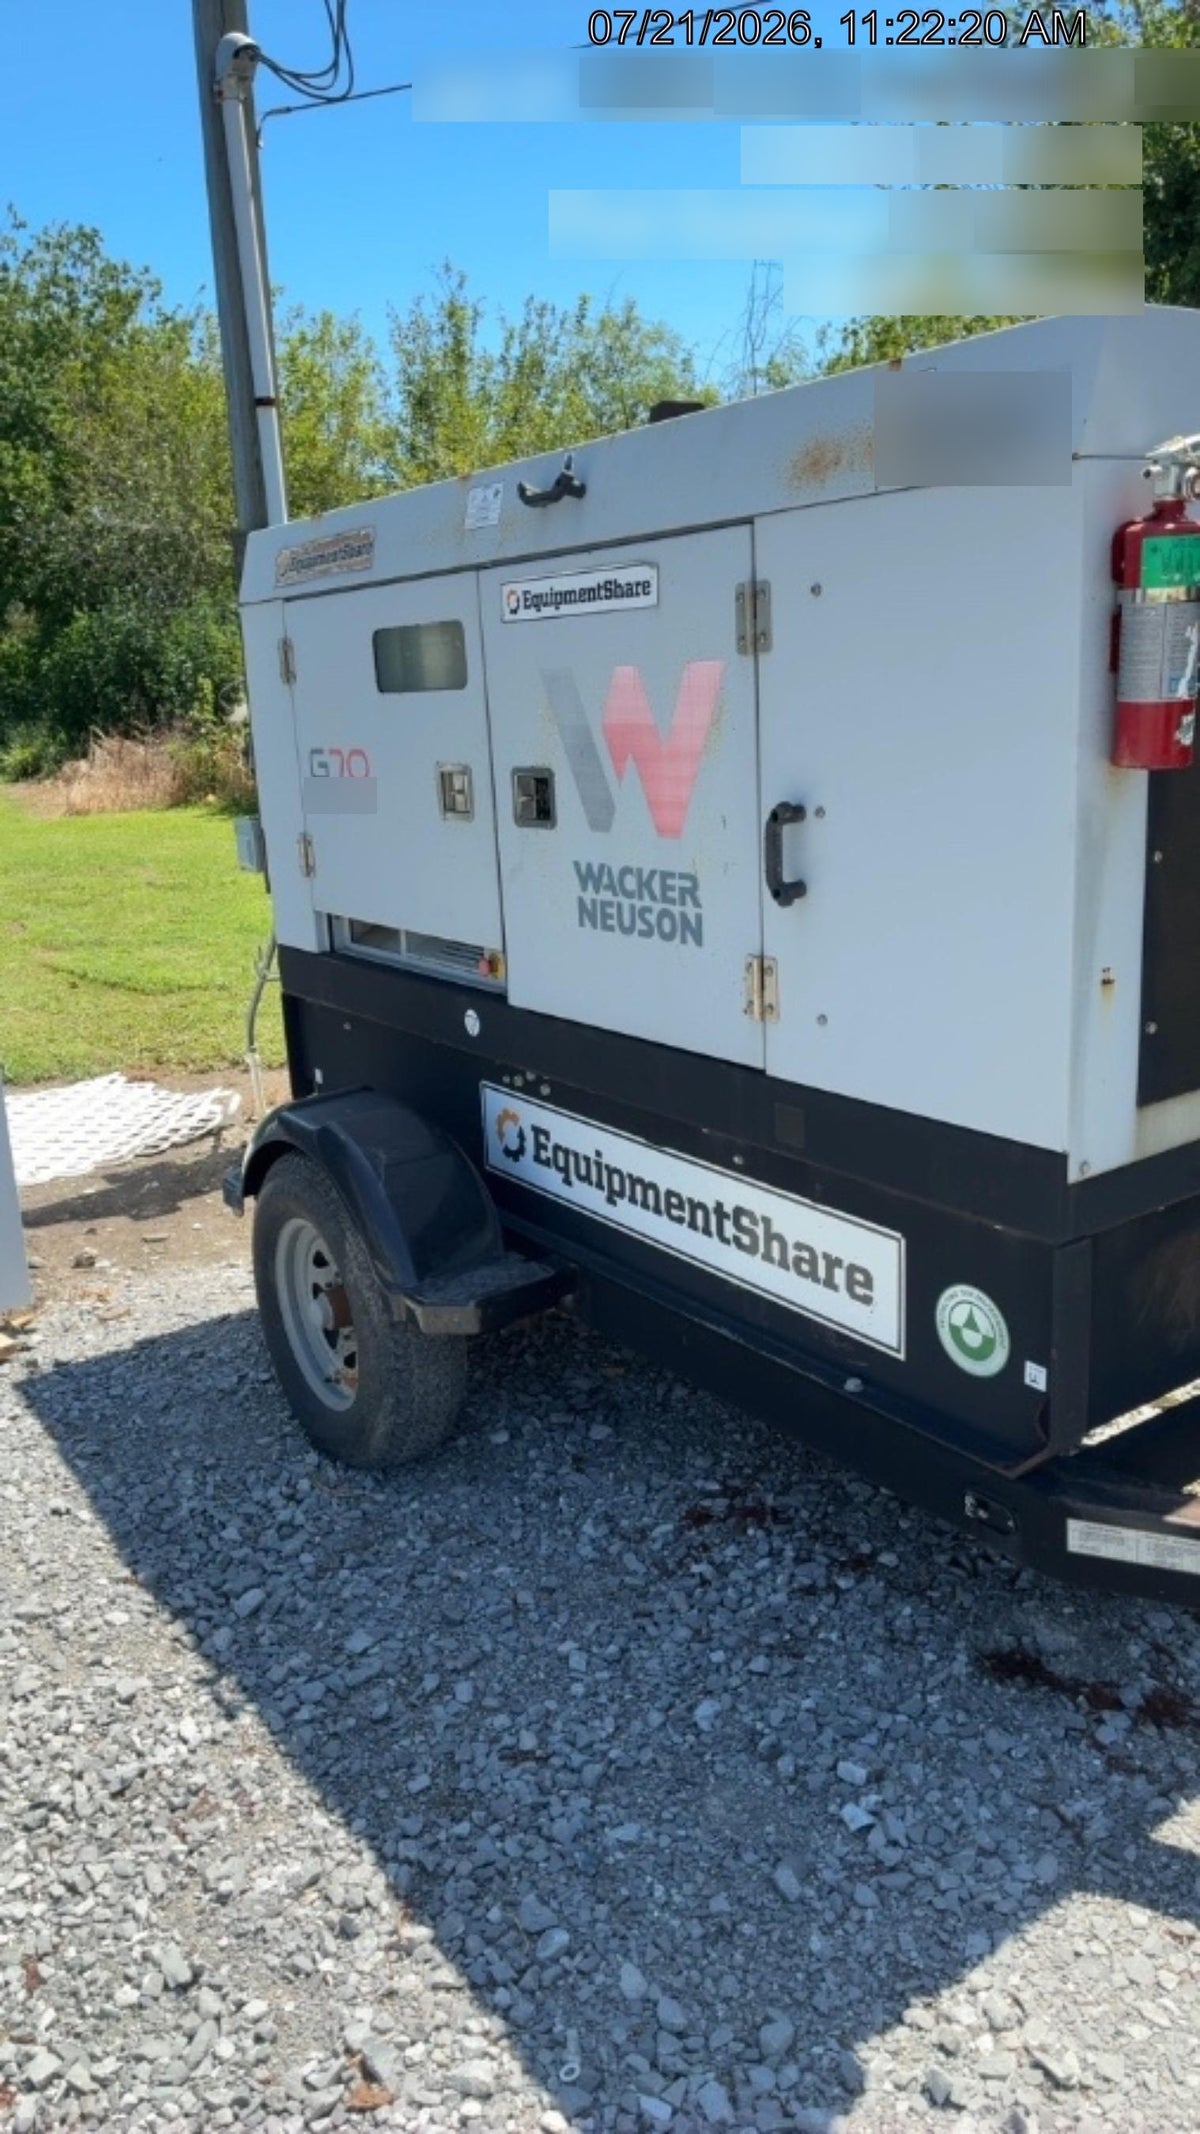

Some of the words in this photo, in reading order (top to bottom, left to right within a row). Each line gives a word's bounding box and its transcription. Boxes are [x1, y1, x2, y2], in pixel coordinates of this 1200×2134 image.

[523, 578, 651, 612] EquipmentShare
[310, 748, 370, 778] G70
[573, 860, 702, 909] WACKER
[577, 895, 703, 948] NEUSON
[531, 1124, 874, 1308] EquipmentShare
